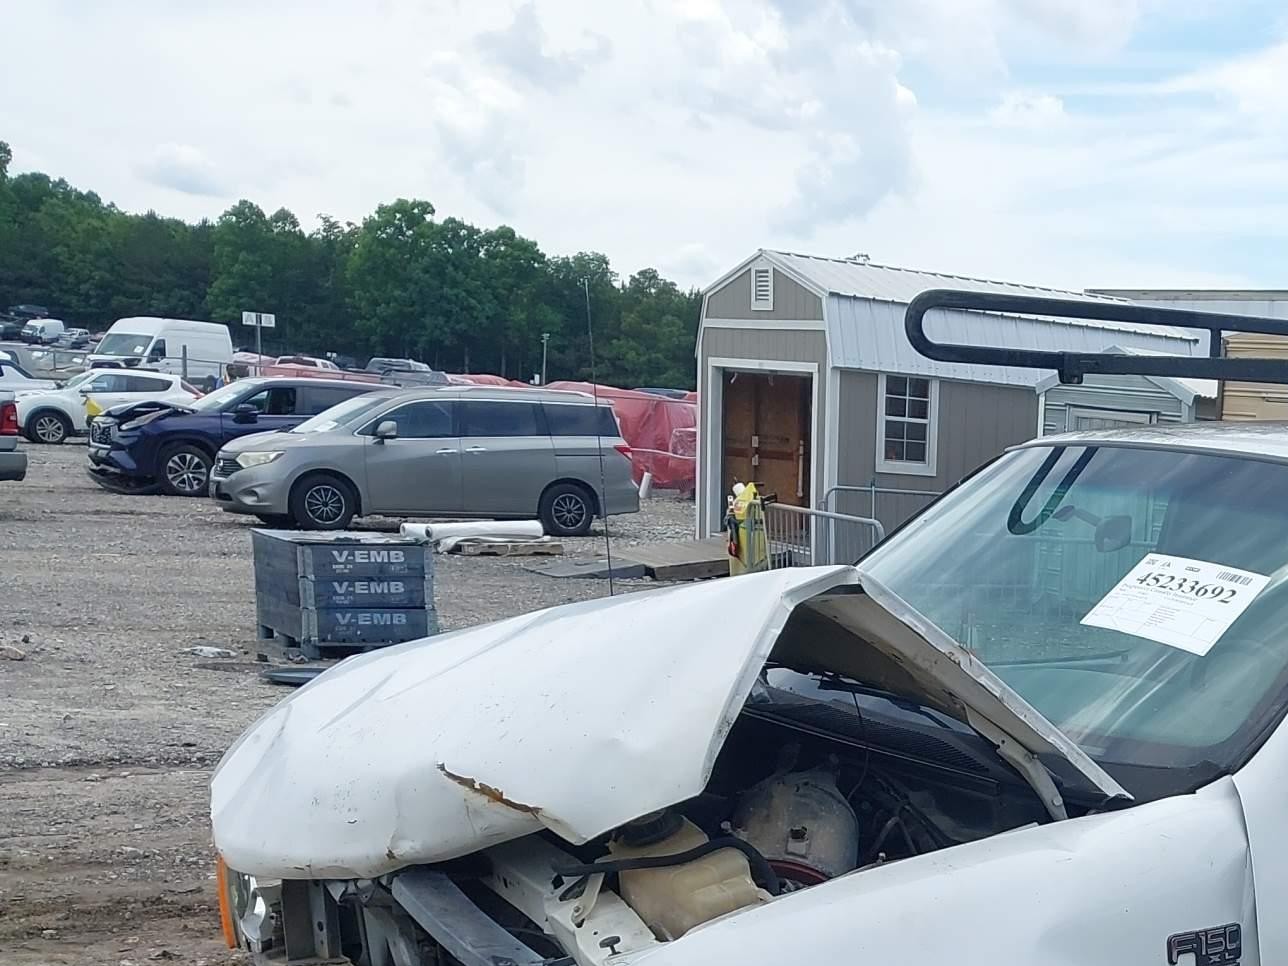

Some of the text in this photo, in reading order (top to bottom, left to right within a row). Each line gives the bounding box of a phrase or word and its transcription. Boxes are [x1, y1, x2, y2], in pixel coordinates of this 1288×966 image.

[331, 550, 405, 563] V-EMB
[332, 581, 405, 594] V-EMB
[1136, 571, 1237, 604] 45233692
[335, 613, 407, 625] V-EMB
